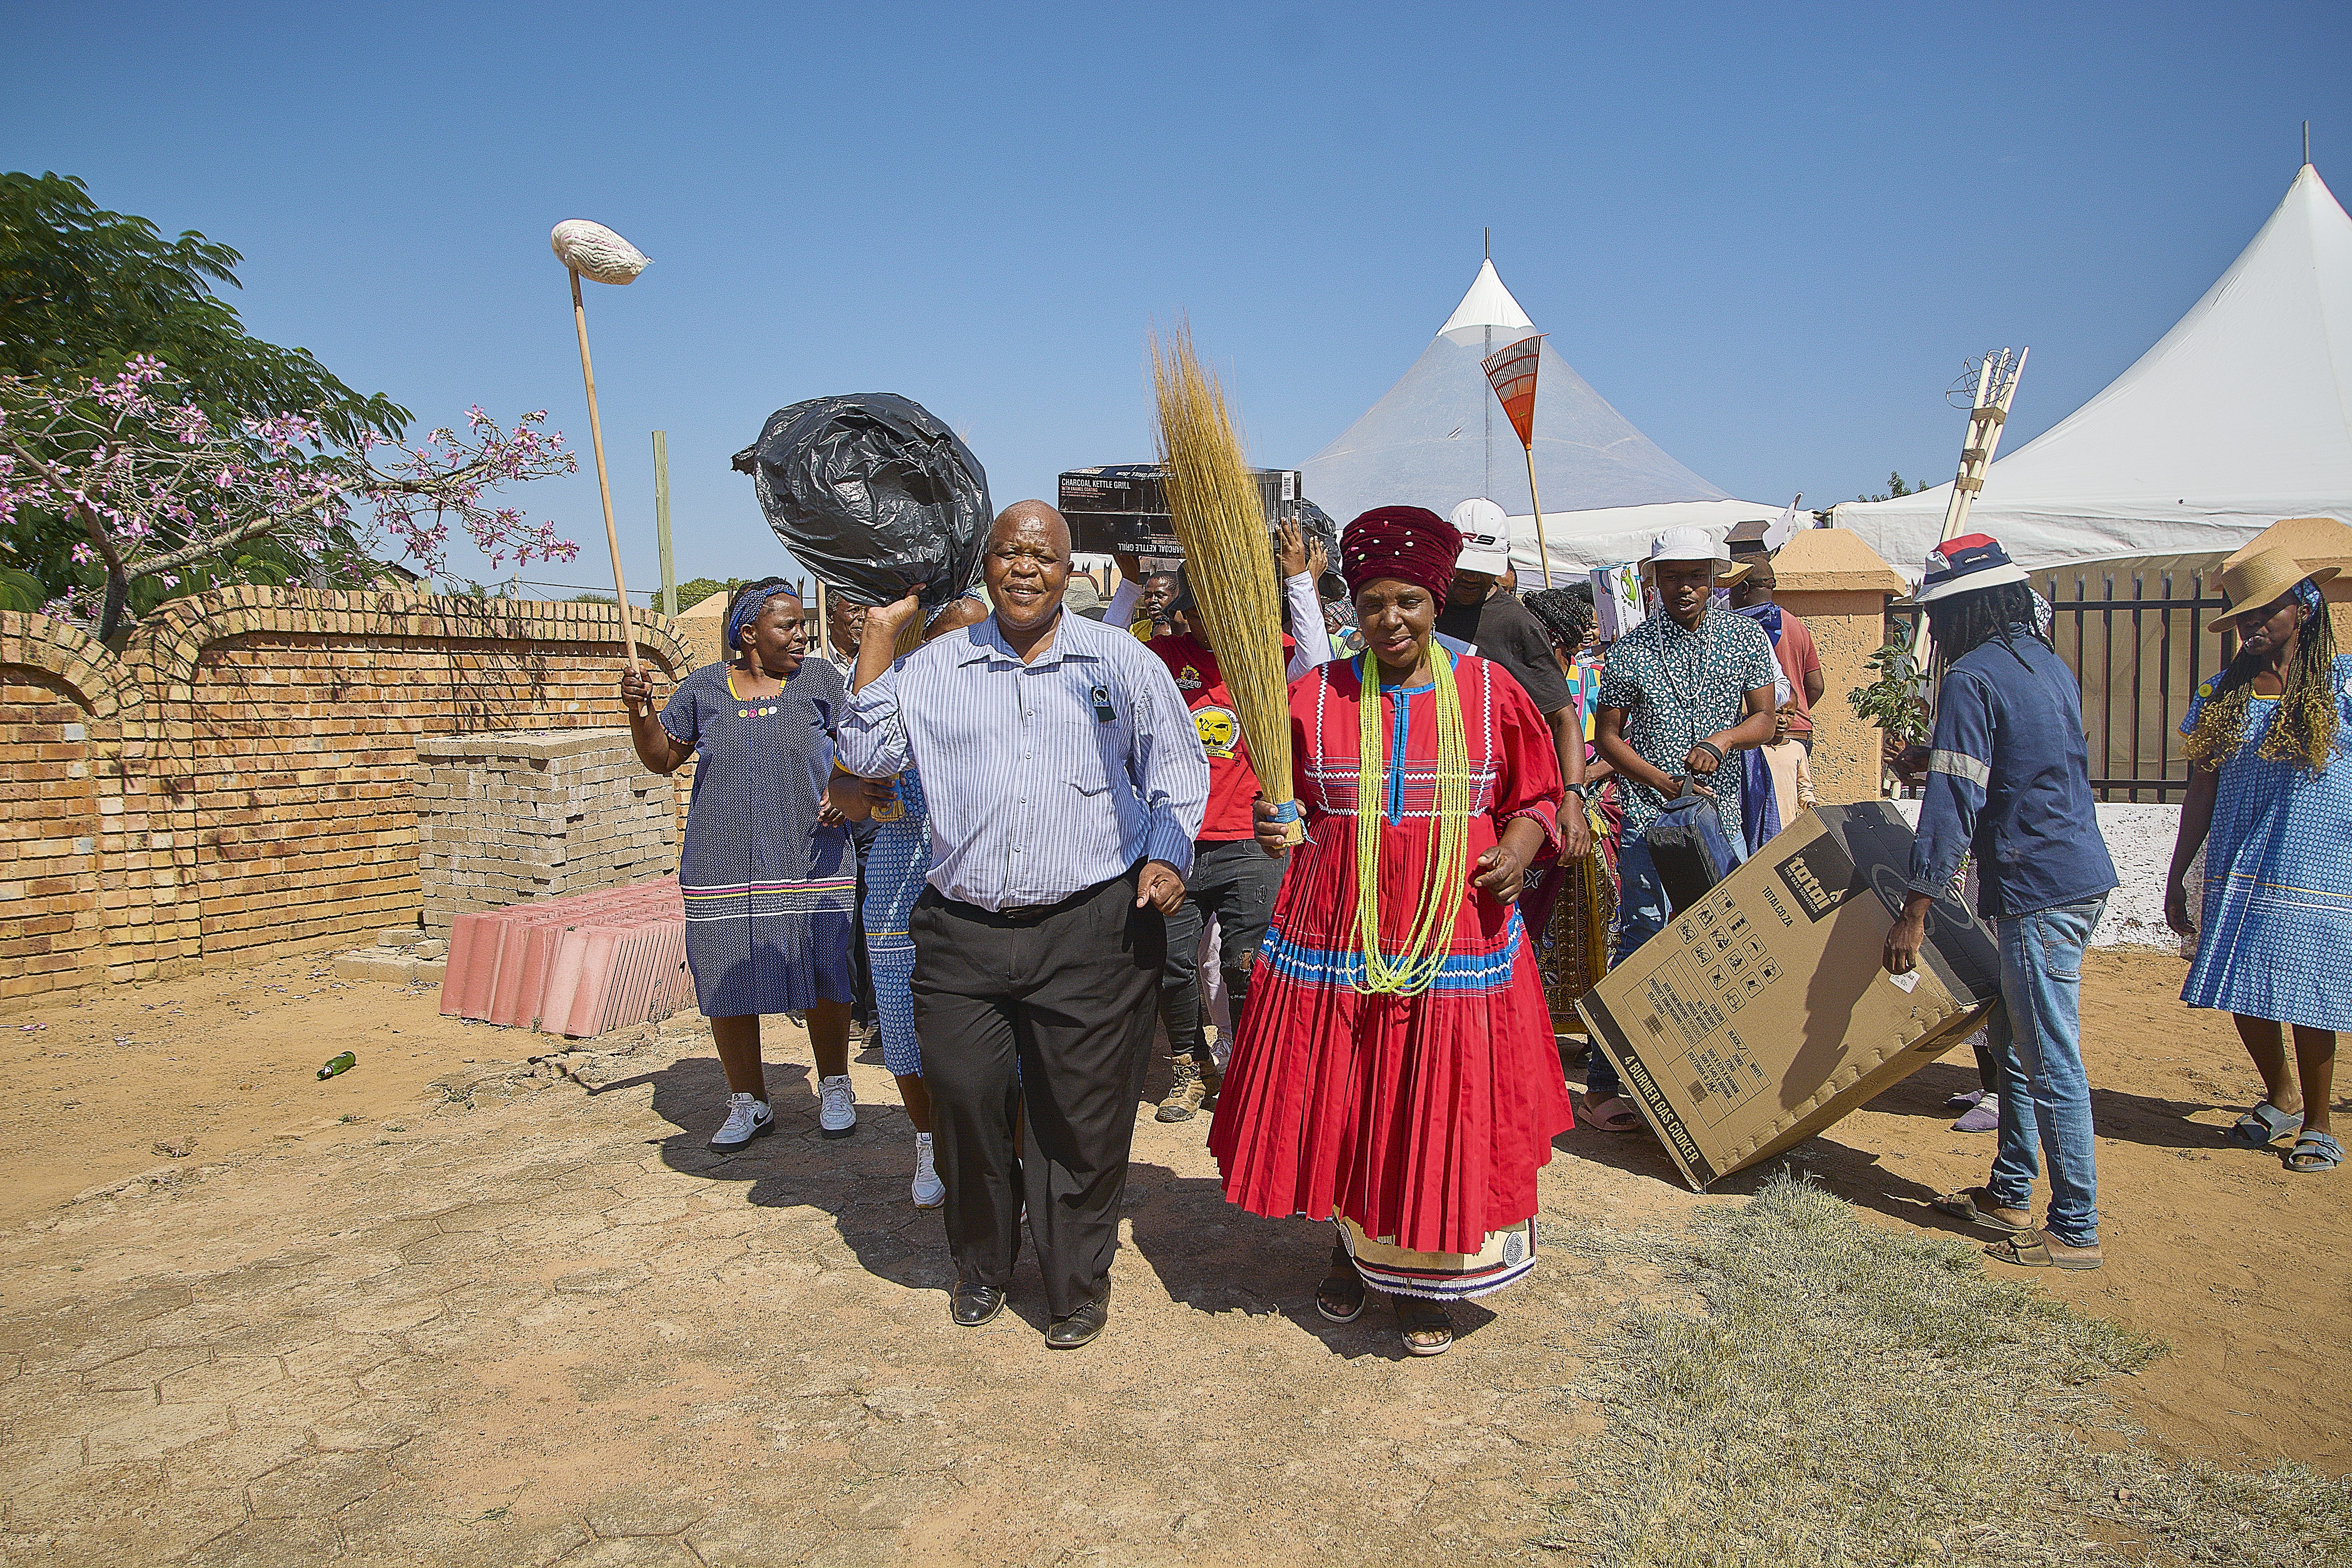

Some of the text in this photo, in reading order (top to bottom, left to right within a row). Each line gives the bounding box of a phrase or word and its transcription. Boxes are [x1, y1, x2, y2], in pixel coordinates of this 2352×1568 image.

[1062, 478, 1131, 489] CHARCOAL KETTLE GRILL
[1117, 543, 1184, 553] HARCOAL KETTLE GRILL
[1176, 678, 1202, 688] SAFTU
[1229, 729, 1237, 745] WORKERS
[1784, 867, 1818, 913] THE GAS SOLUTION
[1648, 991, 1665, 1015] 03/T300A
[1649, 977, 1665, 998] PRODUCT
[1662, 997, 1682, 1025] DIMENSIONS
[1700, 1054, 1709, 1064] 500
[1709, 1067, 1718, 1077] 545
[1718, 1080, 1733, 1099] 800MM
[1662, 982, 1672, 993] BOX
[1669, 991, 1690, 1019] DIMENSIONS
[1707, 1048, 1716, 1058] 505
[1716, 1062, 1726, 1073] 575
[1725, 1074, 1740, 1094] 840MM
[1686, 1000, 1736, 1073] GROSS WEIGHT 22KG
[1702, 1009, 1718, 1027] WEIGHT
[1732, 1053, 1744, 1067] 20KG
[1710, 1004, 1763, 1079] COLOUR BLACK WHITE
[1688, 1051, 1709, 1080] 03/T300A-B
[1625, 1056, 1699, 1164] 4 BURNER GAS COOKER
